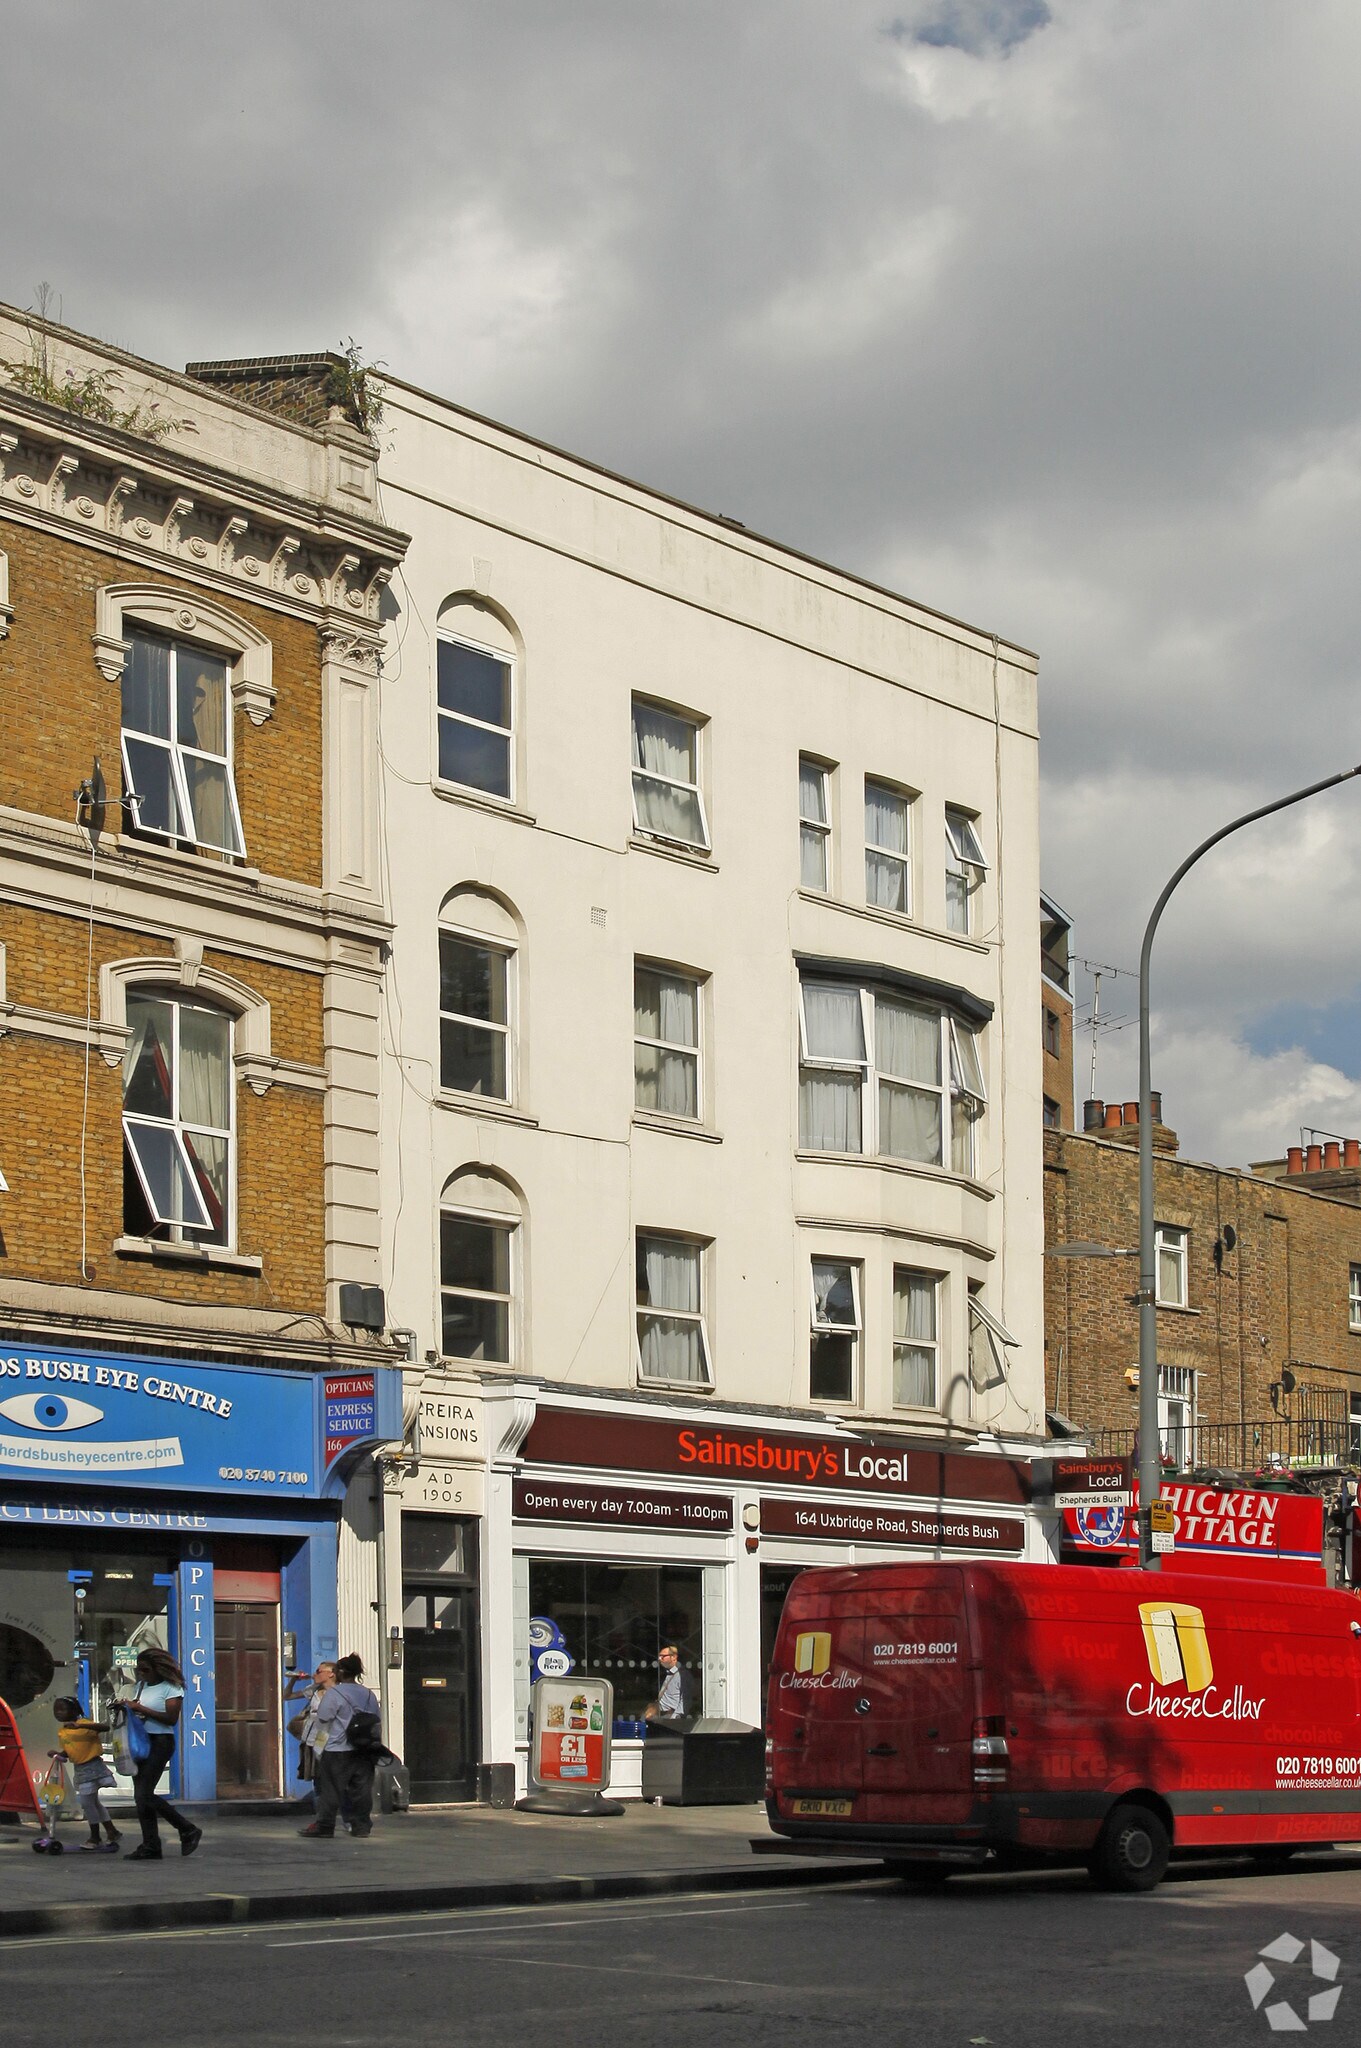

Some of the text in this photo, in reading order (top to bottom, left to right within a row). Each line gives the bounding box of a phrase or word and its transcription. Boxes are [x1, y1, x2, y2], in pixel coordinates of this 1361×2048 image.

[25, 1359, 90, 1383] BUSH
[95, 1366, 139, 1391] EYE
[143, 1377, 233, 1418] CENTRE
[326, 1380, 375, 1394] OPTICIANS
[327, 1403, 373, 1417] EXPRESS
[329, 1418, 372, 1431] SERVICE
[419, 1425, 478, 1443] ANSIONS
[0, 1443, 176, 1466] herdsbusheyecentre.com
[327, 1440, 342, 1451] 166
[678, 1430, 908, 1481] Sainsbury's Local
[219, 1467, 308, 1485] 020 8740 7100
[1058, 1462, 1123, 1475] Sainsbury's
[1088, 1474, 1122, 1487] Local
[423, 1489, 463, 1502] 1905
[1059, 1495, 1123, 1505] Shepherds Bush
[1134, 1486, 1279, 1520] HICKEN
[0, 1500, 208, 1528] CT LENS CENTRE
[525, 1493, 559, 1508] Open
[562, 1498, 598, 1513] every
[601, 1499, 624, 1514] day
[626, 1500, 672, 1516] 7.00am
[682, 1505, 729, 1521] 11.00pm
[794, 1512, 999, 1539] 164 Uxbridge Road, Shepherds Bush
[1132, 1514, 1276, 1546] TTAGE
[1094, 1569, 1175, 1593] butter
[189, 1541, 208, 1748] OPTICIAN
[873, 1643, 958, 1656] 020 7819 6001
[1062, 1635, 1119, 1660] flour
[873, 1657, 957, 1666] www.cheesecellar.co.uk
[1260, 1643, 1361, 1674] cheese
[779, 1671, 863, 1689] CheeseCellar
[1126, 1682, 1266, 1721] CheeseCellar
[1264, 1724, 1343, 1744] chocolate
[560, 1735, 586, 1757] £1
[1276, 1757, 1361, 1775] 020 7819 6001
[1180, 1767, 1250, 1789] biscuits
